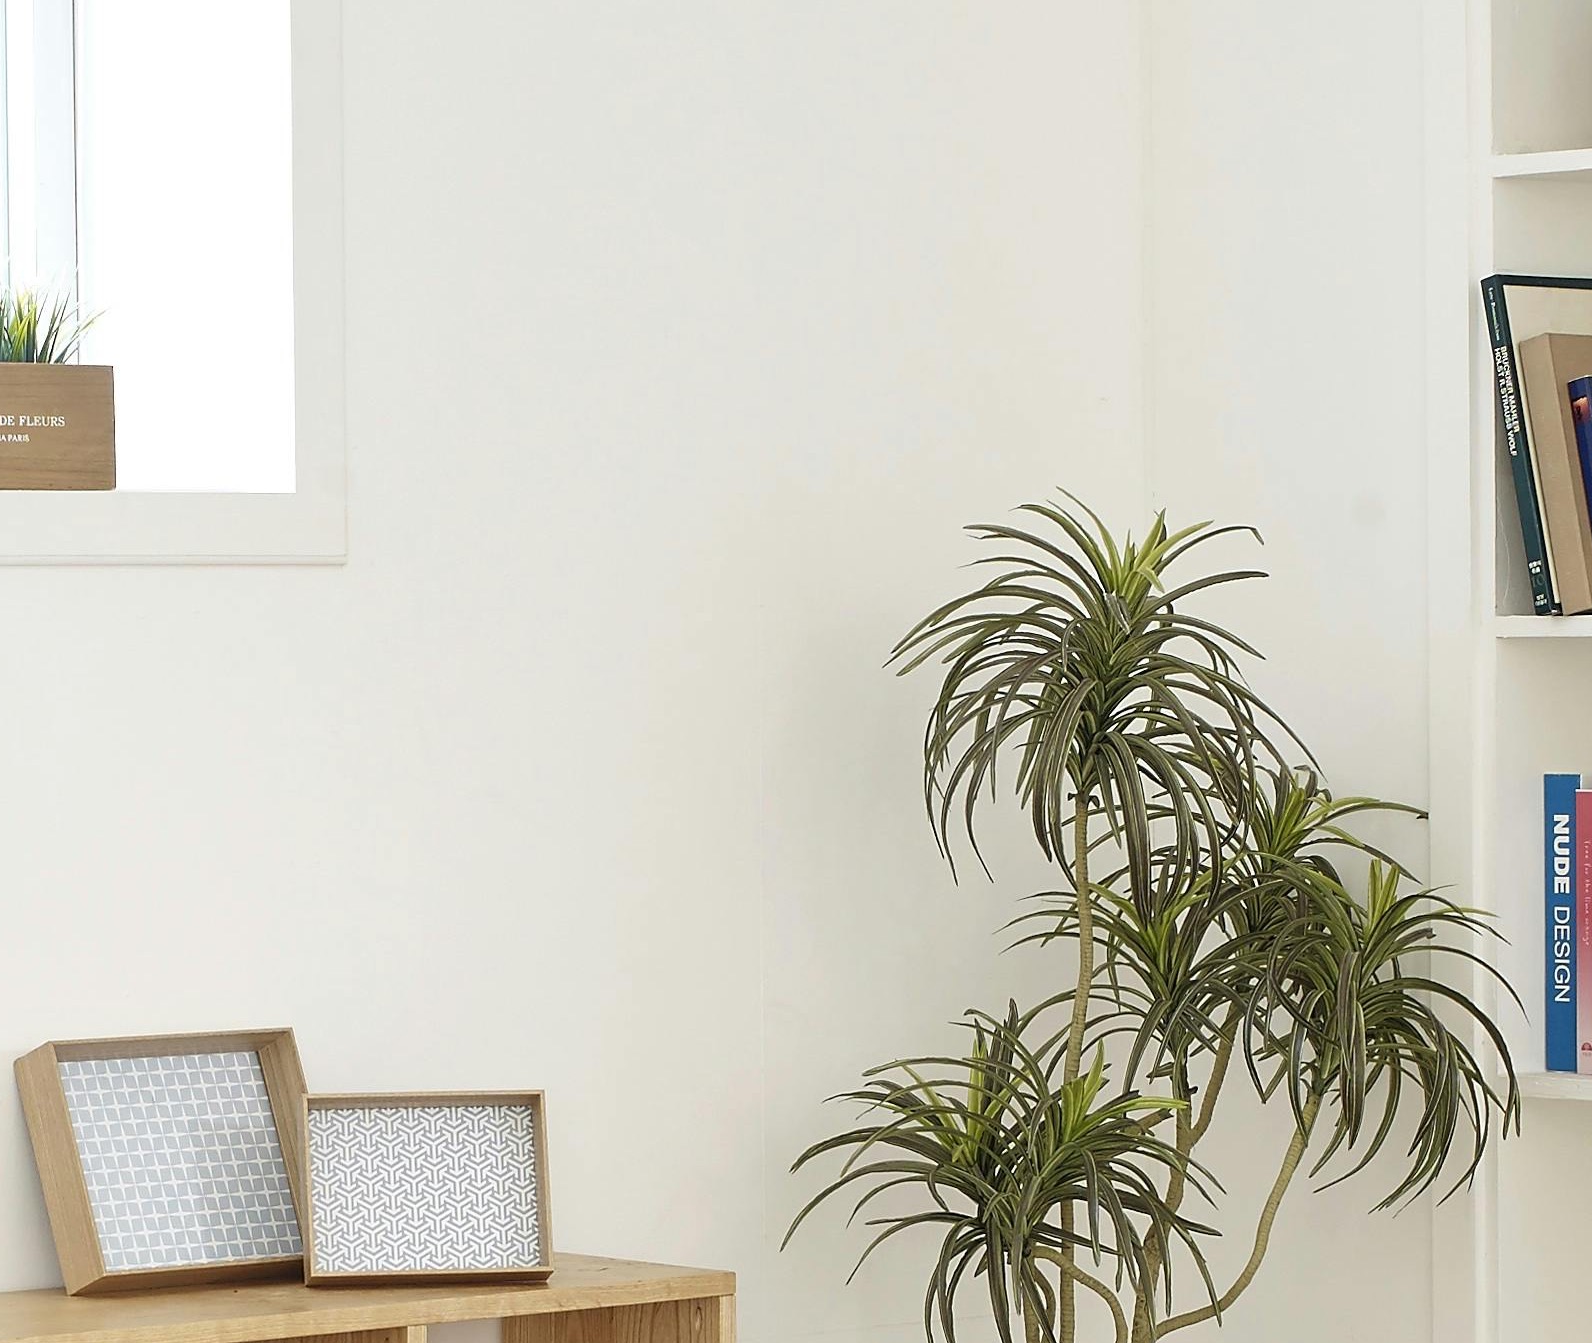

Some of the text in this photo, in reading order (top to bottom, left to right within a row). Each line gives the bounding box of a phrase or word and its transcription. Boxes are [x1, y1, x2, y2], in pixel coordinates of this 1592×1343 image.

[19, 415, 66, 427] FLEURS
[1553, 813, 1570, 1003] NUDE DESIGN
